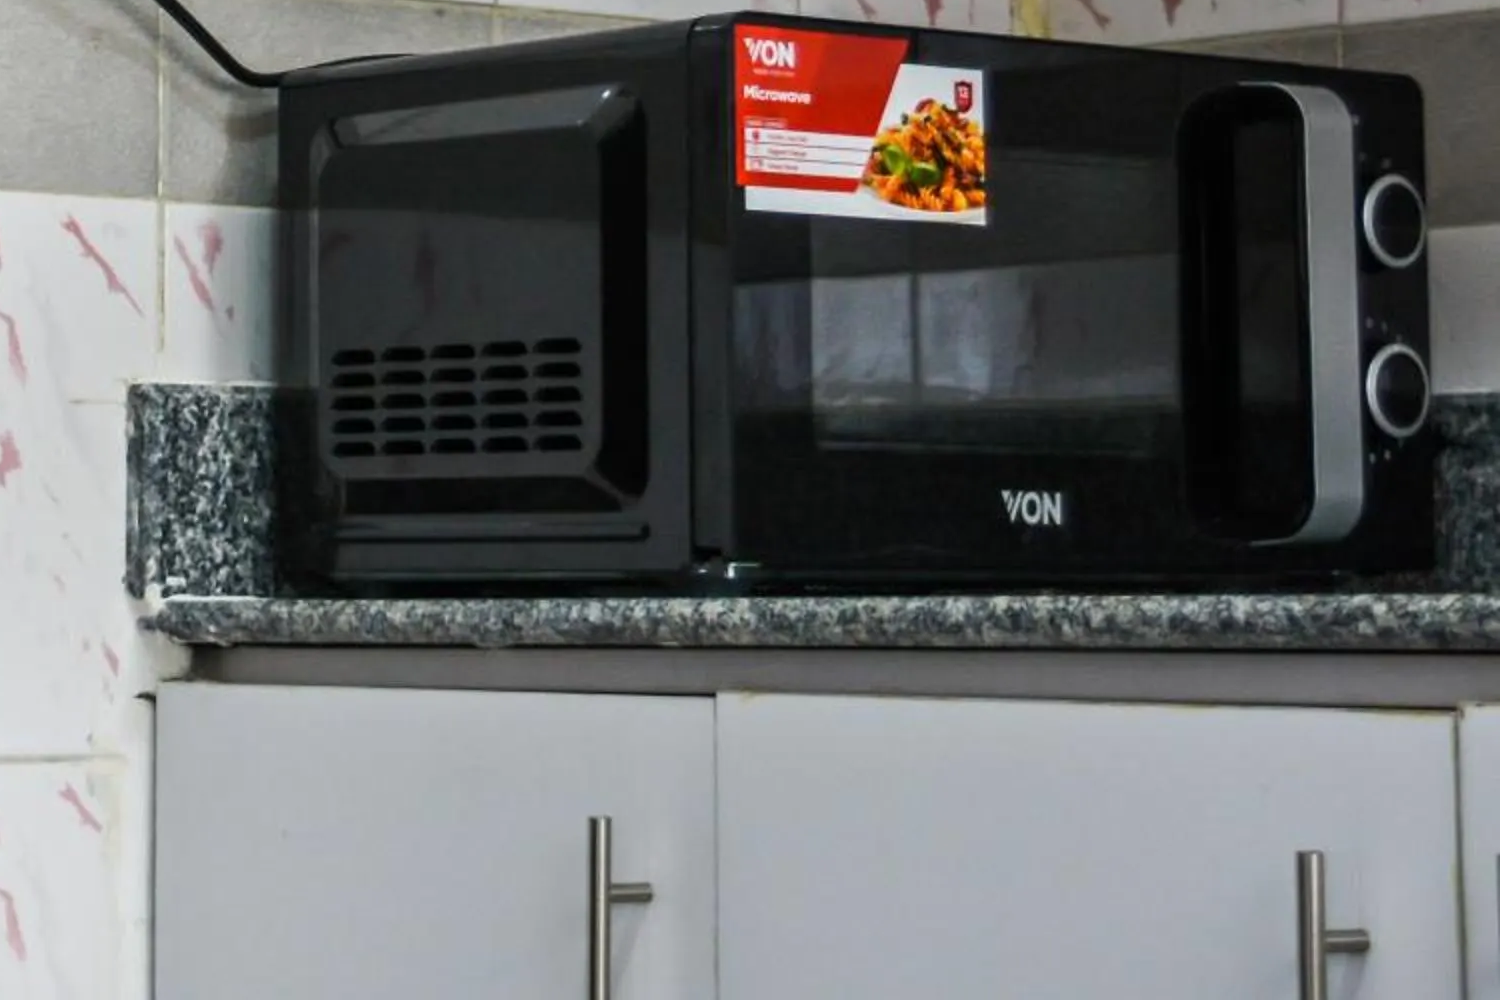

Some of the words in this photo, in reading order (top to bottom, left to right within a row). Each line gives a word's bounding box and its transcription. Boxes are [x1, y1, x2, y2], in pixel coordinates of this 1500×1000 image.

[744, 37, 796, 69] VON
[743, 84, 811, 104] Microwave
[1001, 489, 1061, 525] VON
